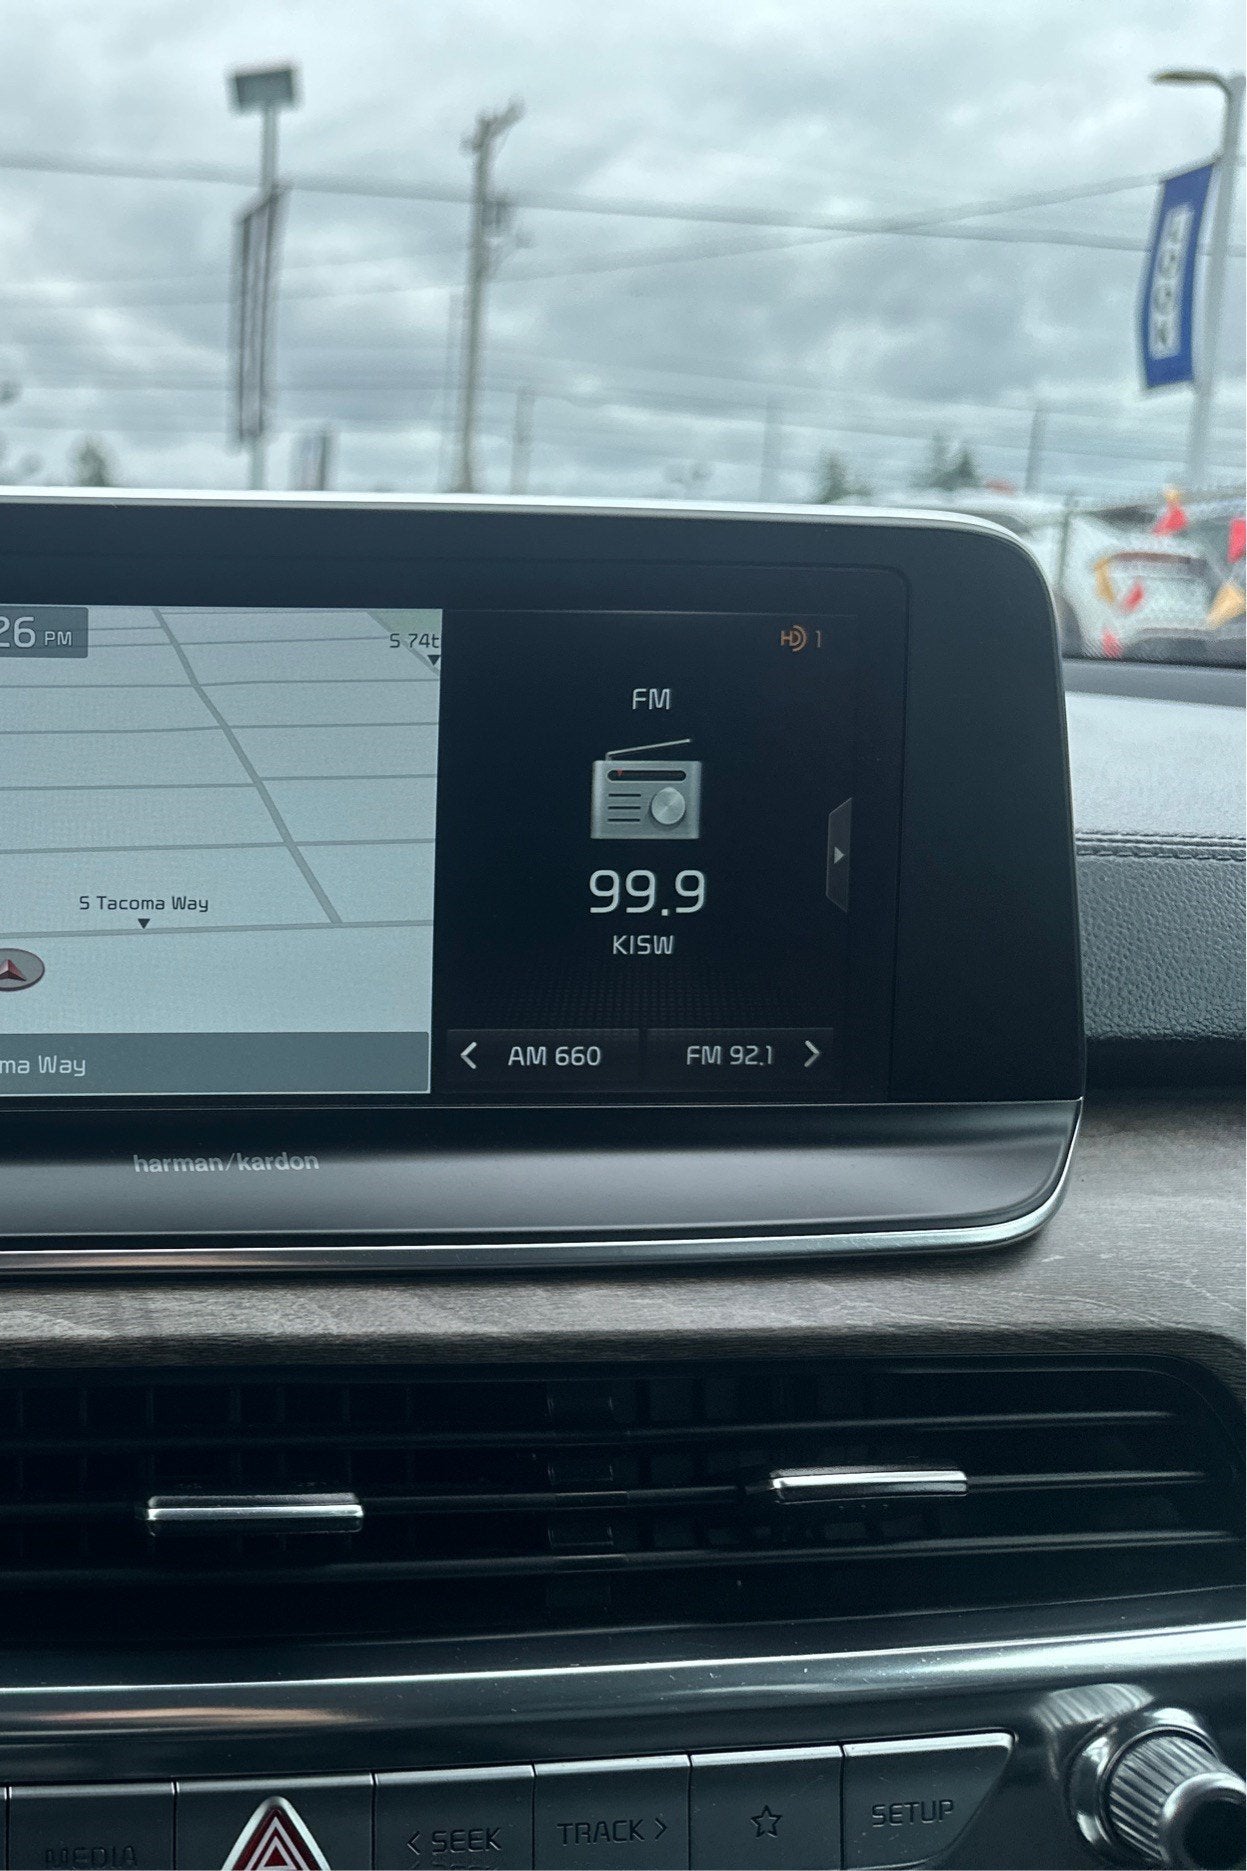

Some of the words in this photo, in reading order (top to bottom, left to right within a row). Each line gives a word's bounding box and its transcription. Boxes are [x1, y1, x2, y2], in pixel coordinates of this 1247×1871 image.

[44, 630, 72, 646] PM
[389, 633, 401, 649] S
[815, 630, 821, 648] 1
[632, 688, 671, 710] FM
[589, 869, 707, 916] 99.9
[79, 895, 90, 910] S
[96, 895, 165, 910] Tacoma
[171, 895, 209, 913] Way
[612, 935, 674, 955] KISW
[38, 1055, 86, 1077] Way
[508, 1047, 547, 1066] AM
[555, 1046, 602, 1066] 660
[686, 1046, 721, 1065] FM
[729, 1046, 773, 1067] 92.1
[872, 1800, 954, 1827] SETUP
[431, 1827, 501, 1854] SEEK
[557, 1819, 645, 1846] TRACK
